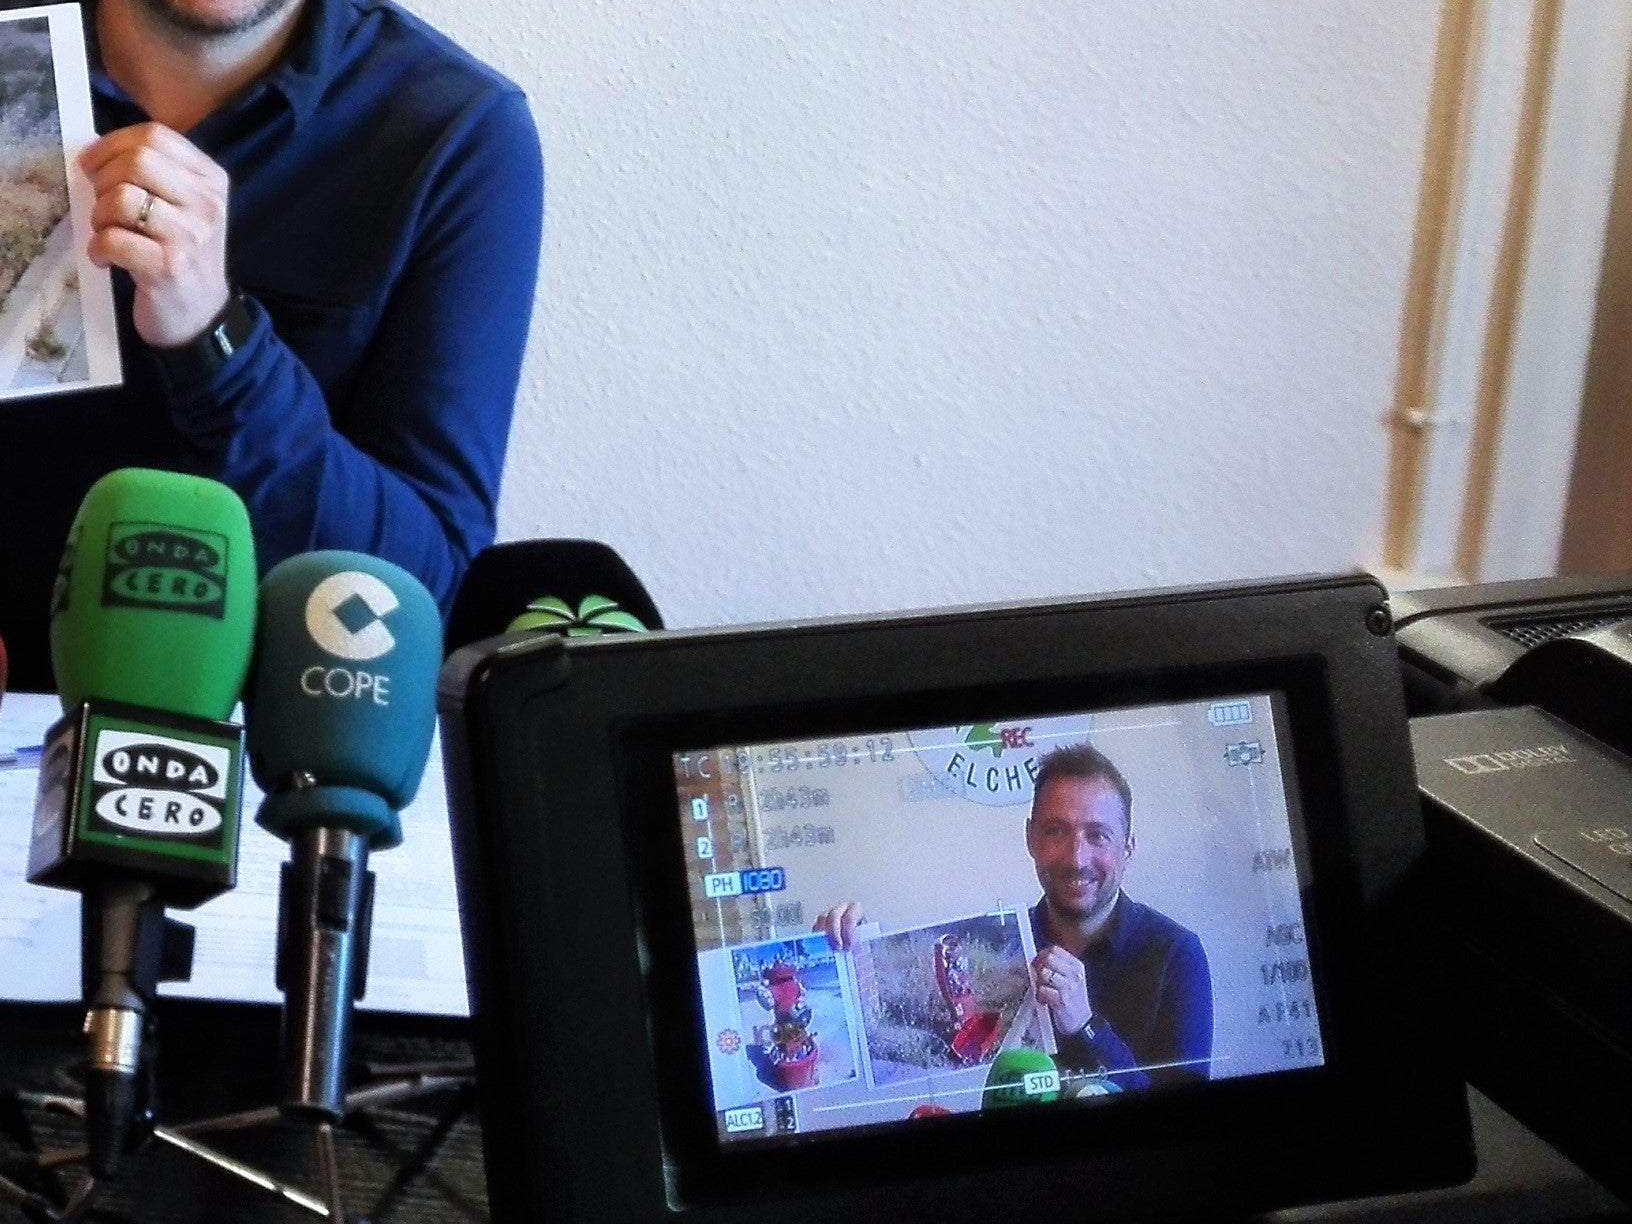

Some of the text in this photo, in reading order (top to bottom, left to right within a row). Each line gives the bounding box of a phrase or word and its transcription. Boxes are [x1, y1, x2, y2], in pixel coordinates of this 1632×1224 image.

[124, 538, 209, 562] ONDA
[126, 573, 208, 599] CERO
[300, 666, 390, 707] COPE
[1000, 726, 1035, 749] REC
[112, 751, 209, 784] ONDA
[946, 752, 1038, 792] ELCHE
[114, 794, 205, 826] CERO
[712, 870, 784, 894] PH 1080
[1029, 1076, 1054, 1090] STD
